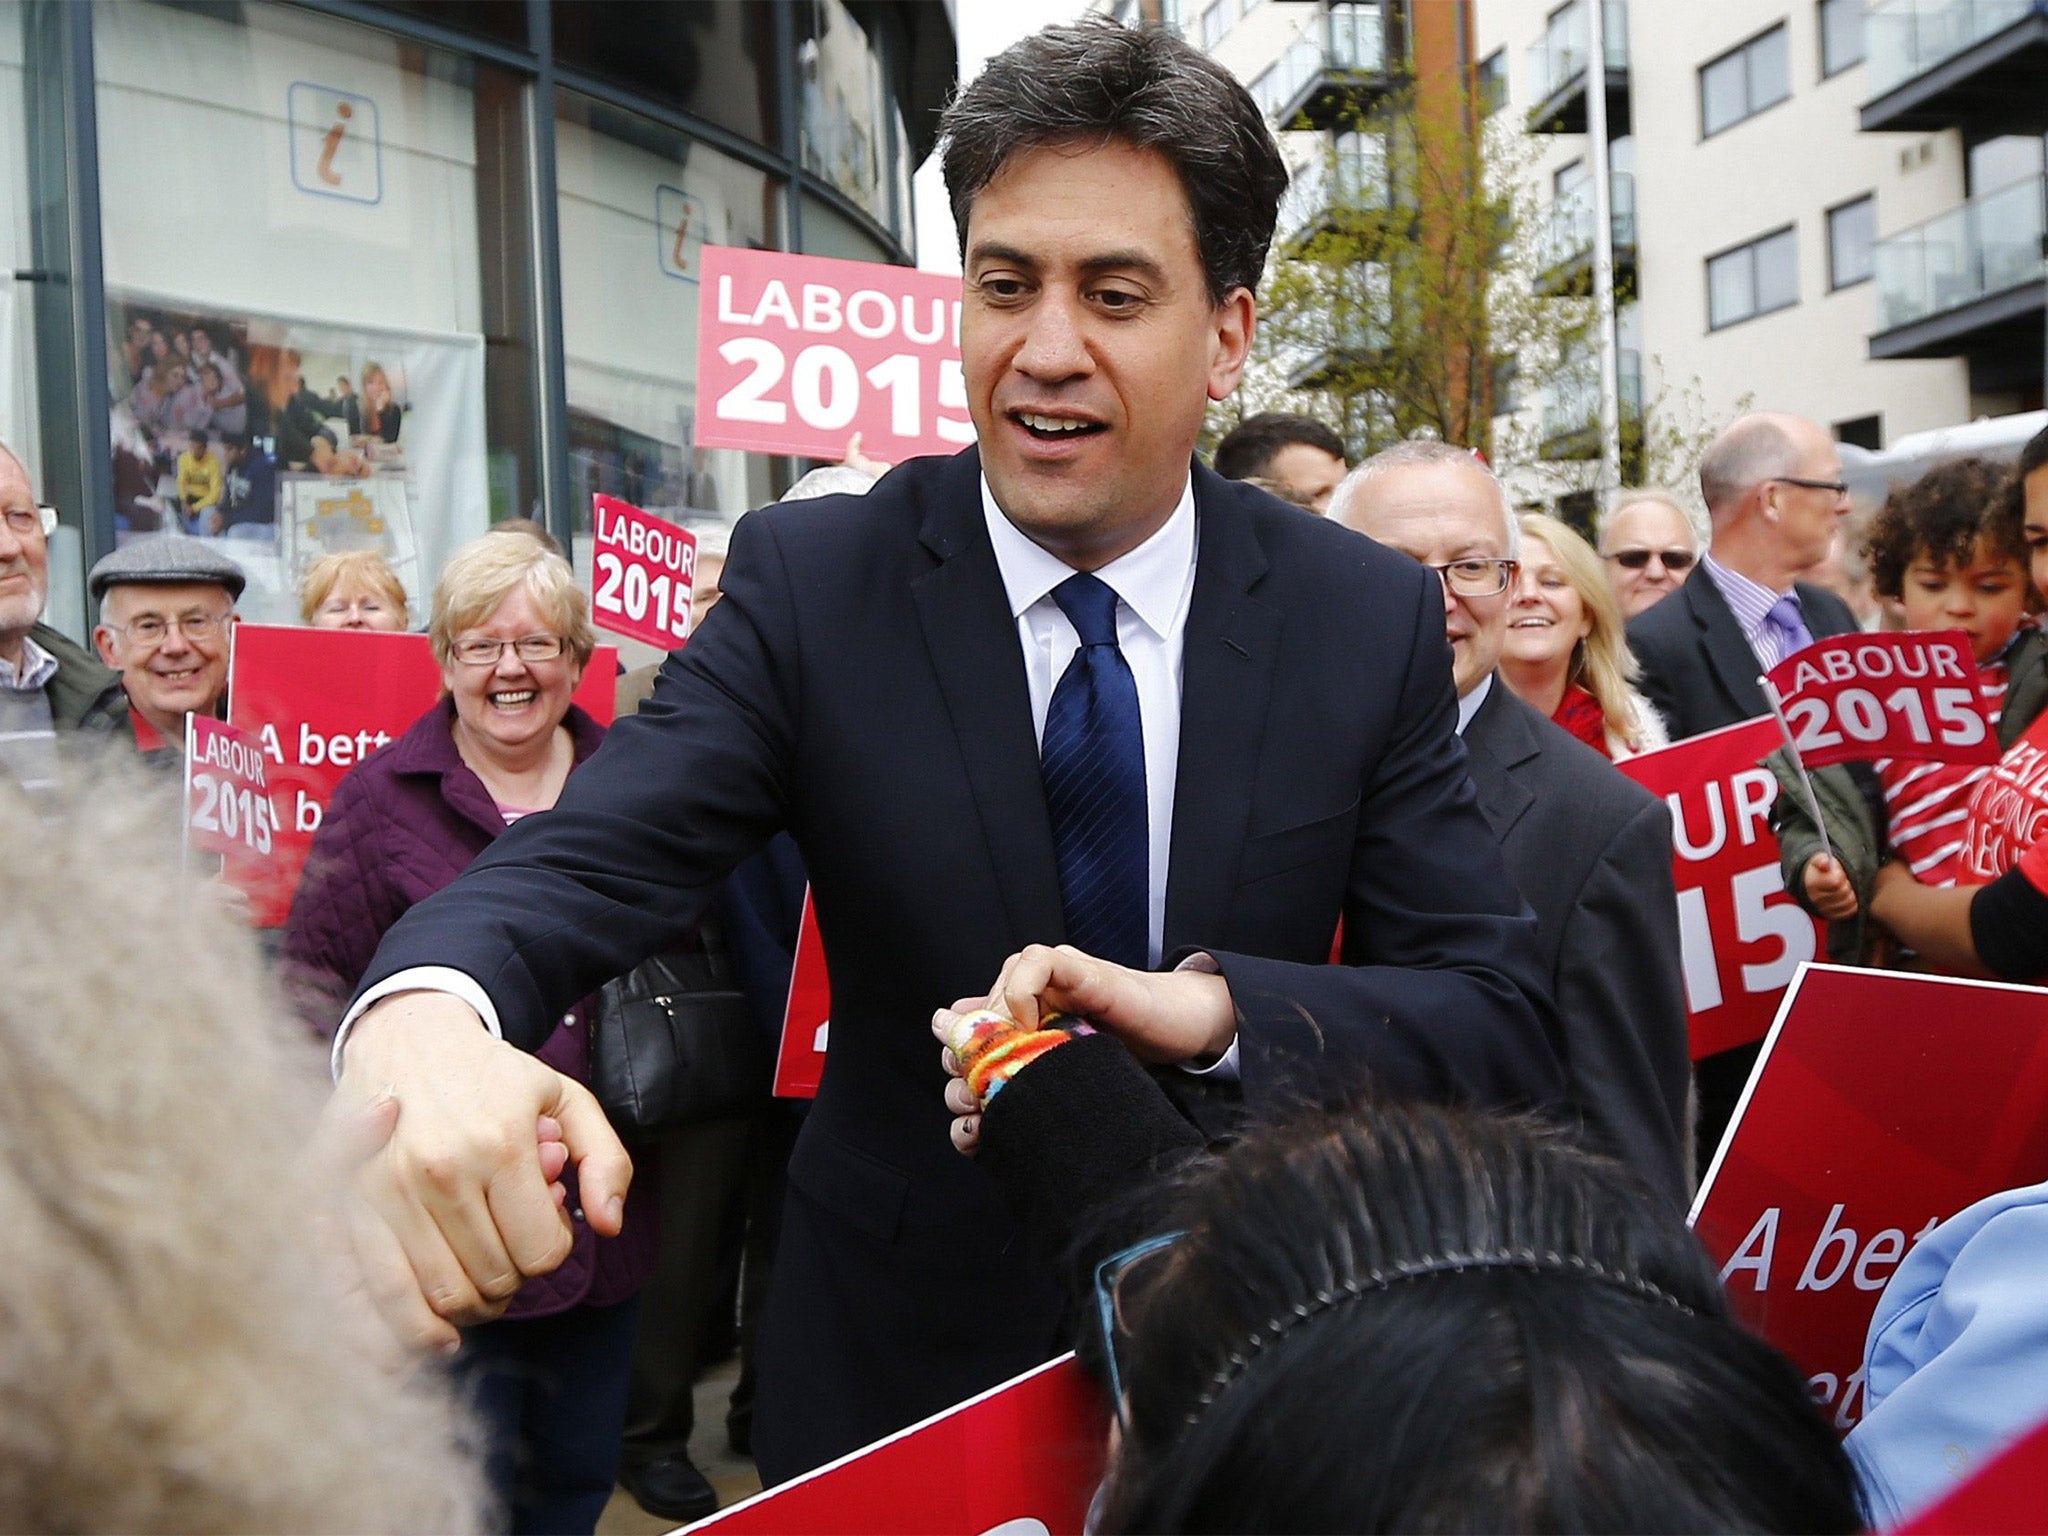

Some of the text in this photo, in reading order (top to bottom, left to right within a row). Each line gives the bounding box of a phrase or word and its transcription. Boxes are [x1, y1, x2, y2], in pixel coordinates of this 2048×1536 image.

[717, 274, 963, 348] LABOU
[597, 507, 694, 579] LABOUR
[595, 552, 692, 640] 2015
[1771, 643, 1967, 705] LABOUR
[260, 723, 284, 764] A
[1785, 686, 1986, 751] 2015
[192, 728, 266, 788] LABOUR
[191, 773, 273, 855] 2015
[1716, 1207, 1781, 1292] A
